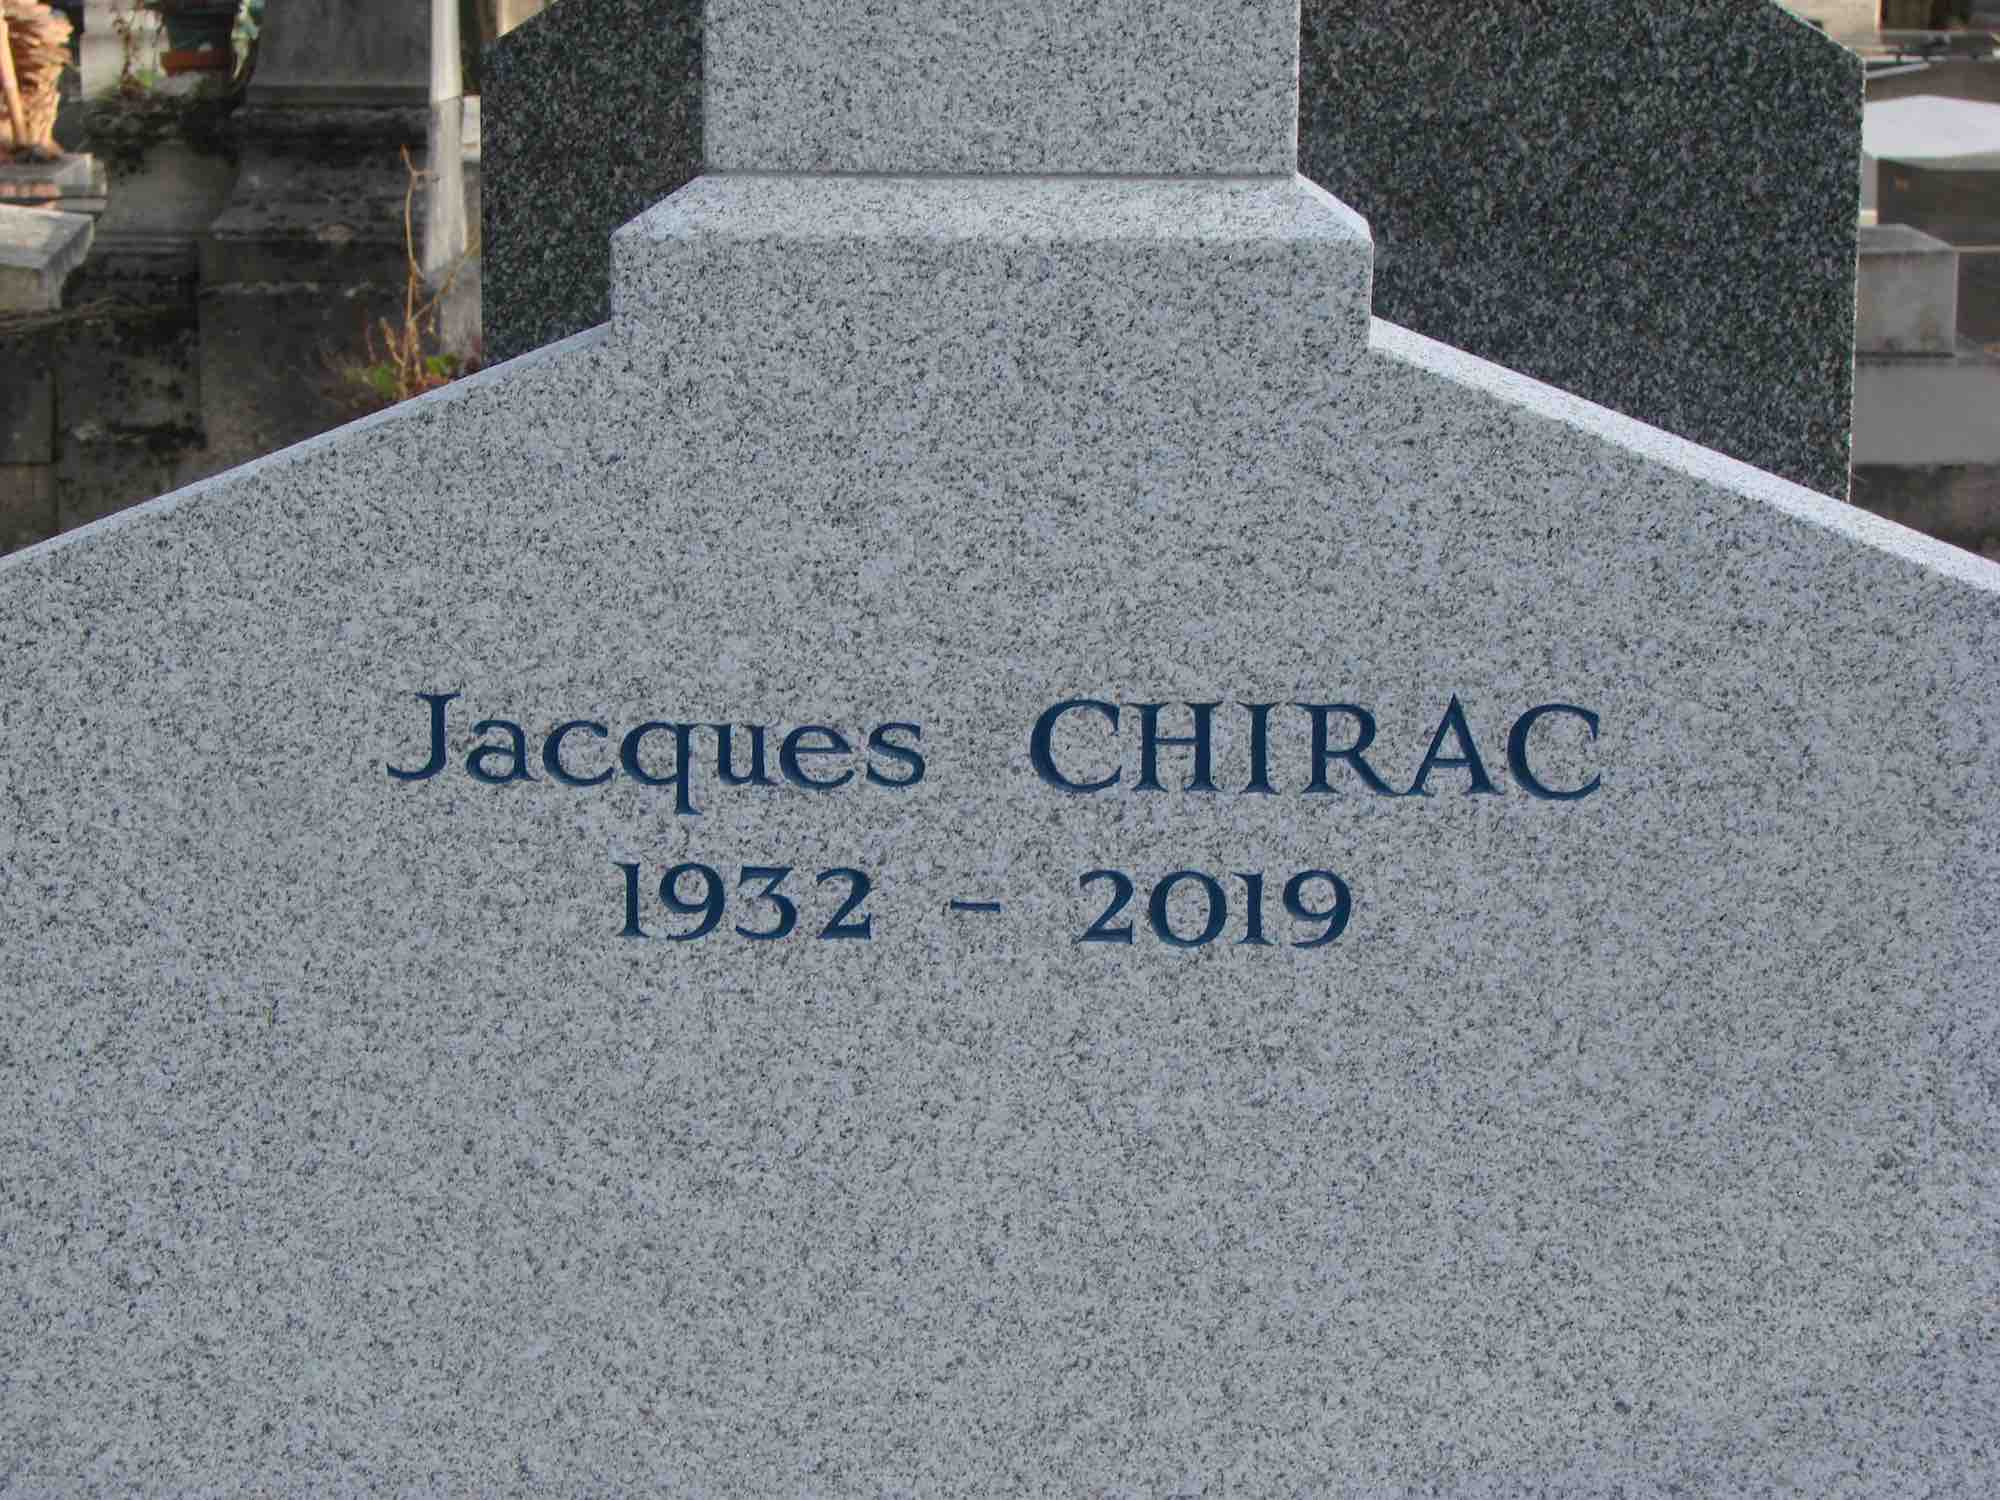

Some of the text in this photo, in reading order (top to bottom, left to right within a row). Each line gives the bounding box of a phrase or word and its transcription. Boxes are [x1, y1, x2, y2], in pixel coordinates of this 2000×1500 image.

[386, 688, 1602, 816] Jacques CHIRAC
[613, 862, 877, 943] 1932
[1071, 869, 1353, 950] 2019
